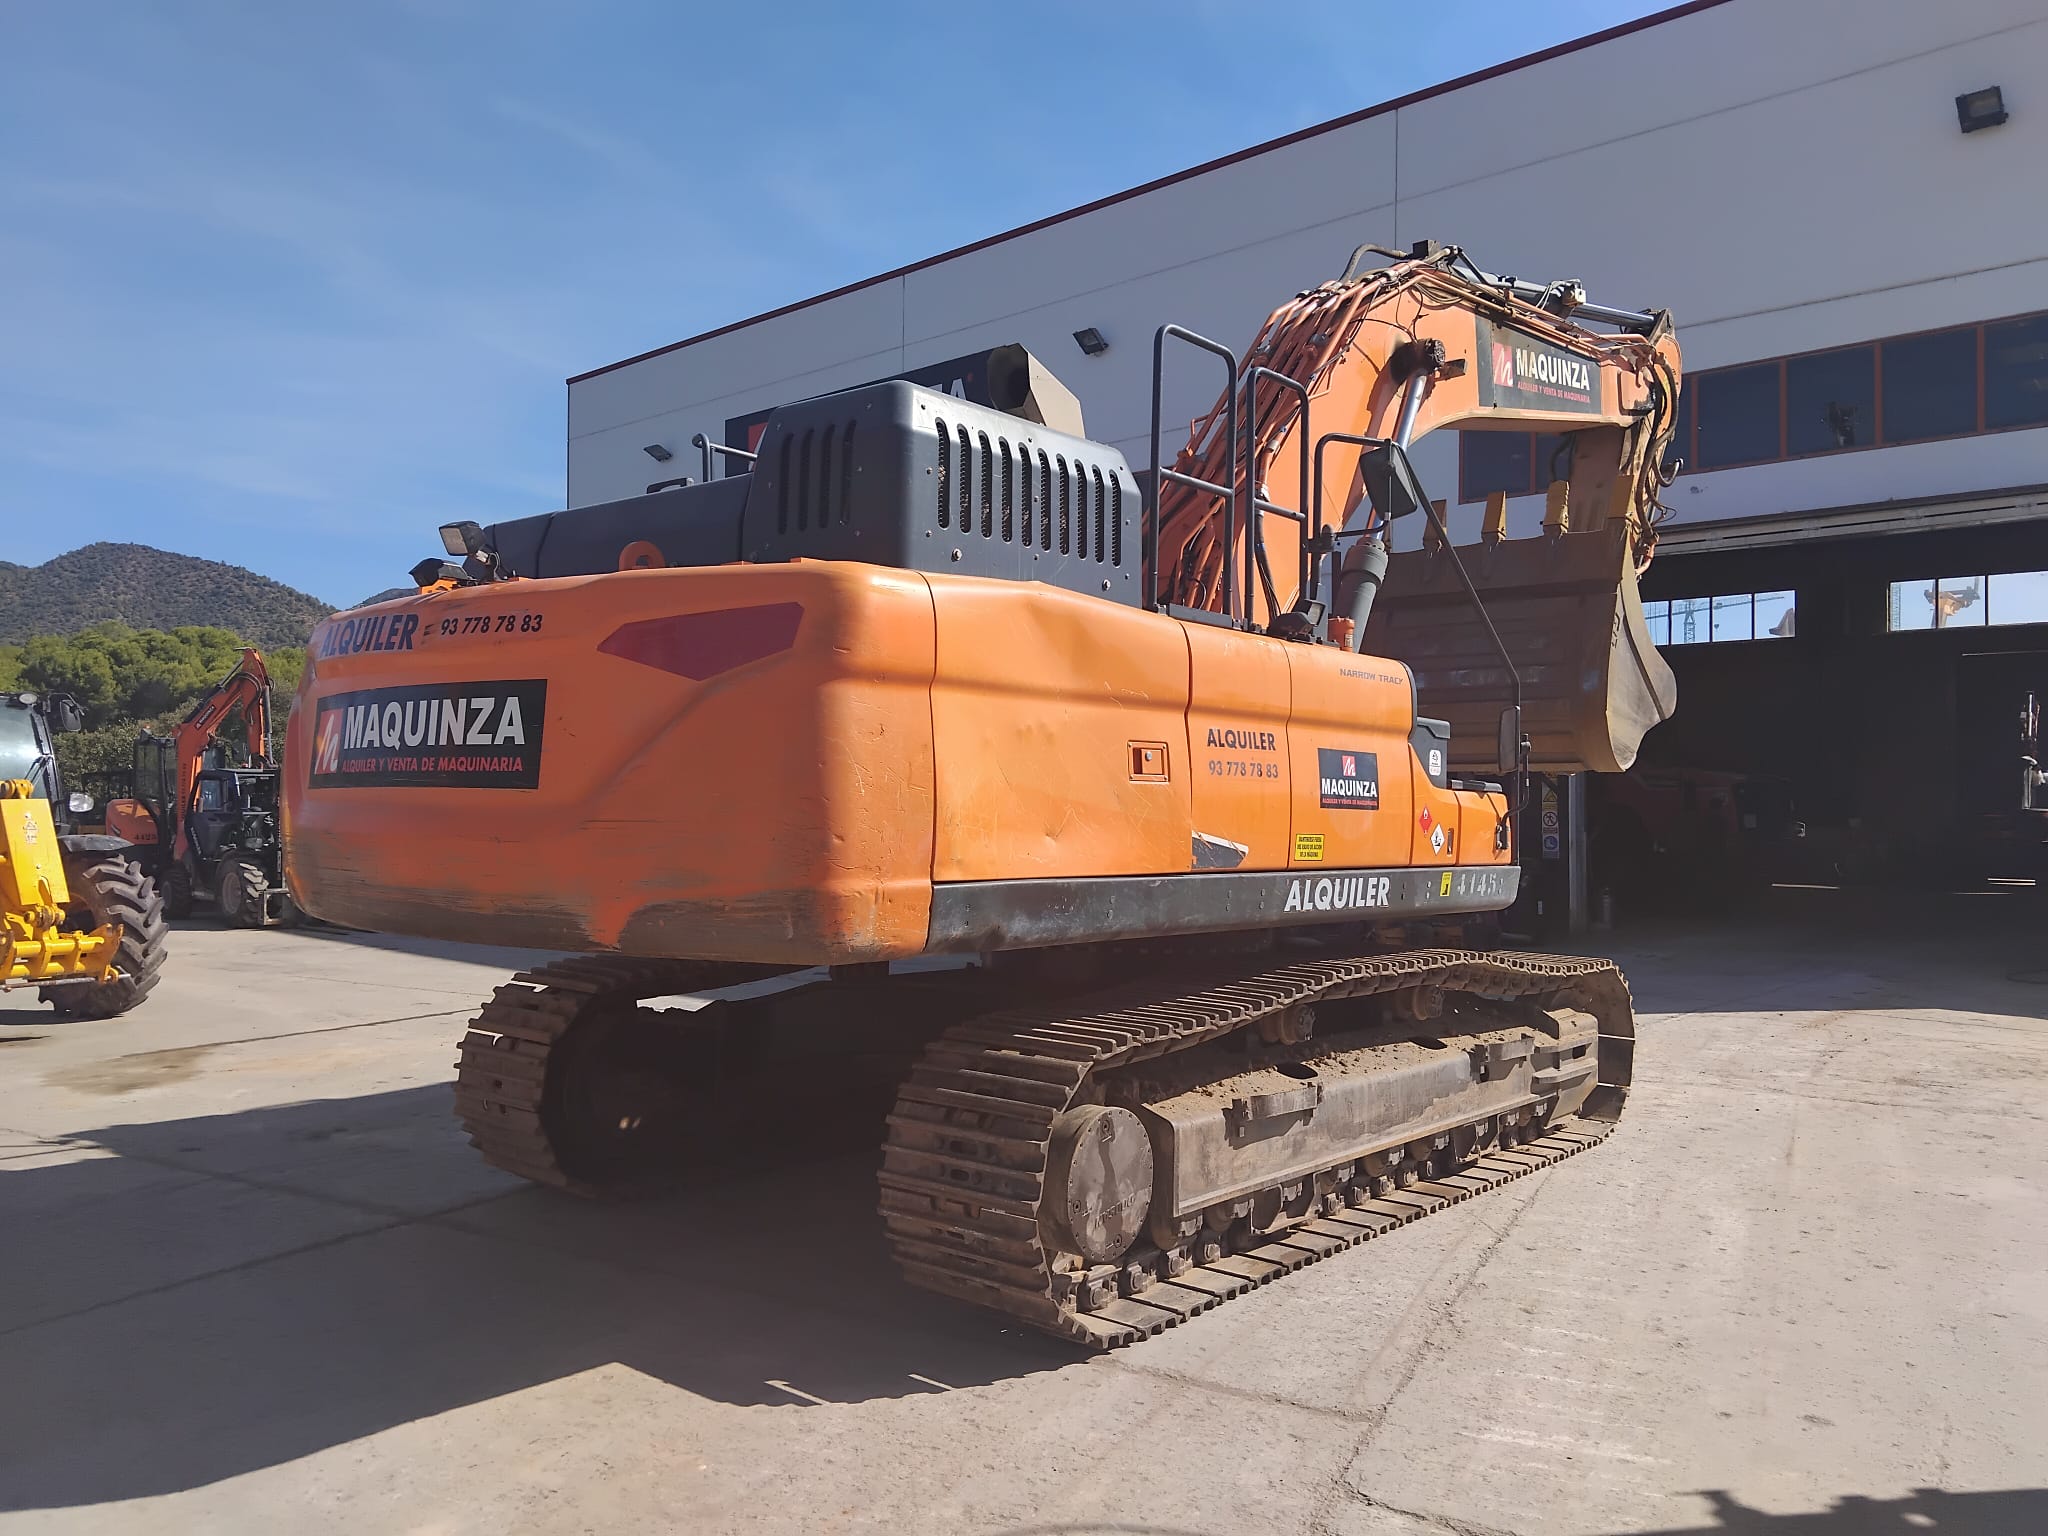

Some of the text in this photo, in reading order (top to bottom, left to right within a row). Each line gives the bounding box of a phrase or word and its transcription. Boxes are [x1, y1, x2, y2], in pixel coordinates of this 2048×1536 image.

[1515, 348, 1591, 391] MAQUINZA
[320, 613, 543, 658] ALQUILER 93 778 78 83
[1339, 668, 1376, 680] NARROW
[343, 696, 526, 751] MAQUINZA
[1207, 728, 1276, 751] ALQUILER
[341, 756, 523, 773] ALQUILER Y VENTA DE MAQUINARIA
[1208, 760, 1279, 779] 93 778 78 83
[1321, 778, 1377, 797] MAQUINZA
[1283, 876, 1390, 912] ALQUILER
